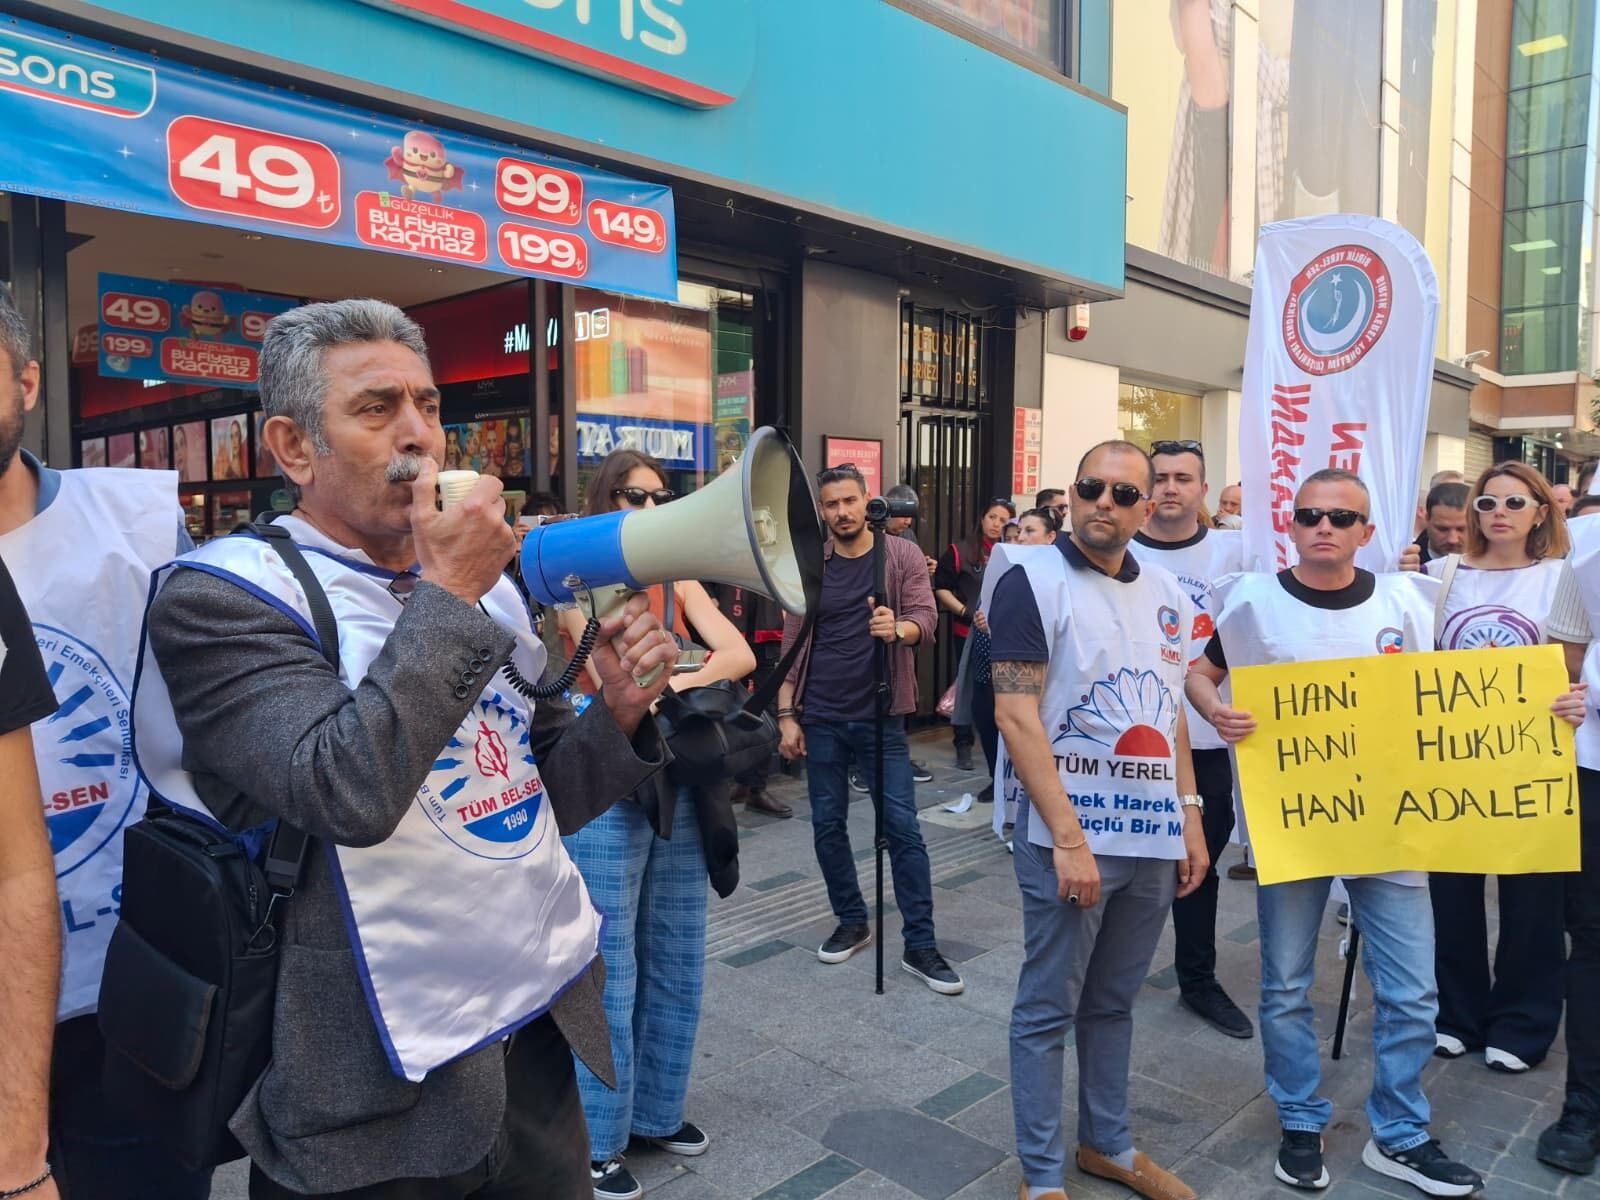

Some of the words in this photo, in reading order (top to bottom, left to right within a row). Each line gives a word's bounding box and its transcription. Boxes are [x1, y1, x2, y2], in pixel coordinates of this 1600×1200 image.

[368, 208, 400, 228] BU
[171, 349, 192, 361] BU
[1053, 752, 1099, 776] TÜM
[1106, 760, 1175, 782] YEREL
[456, 796, 498, 823] TÜM
[502, 808, 529, 831] 1990
[1130, 818, 1161, 835] Bir
